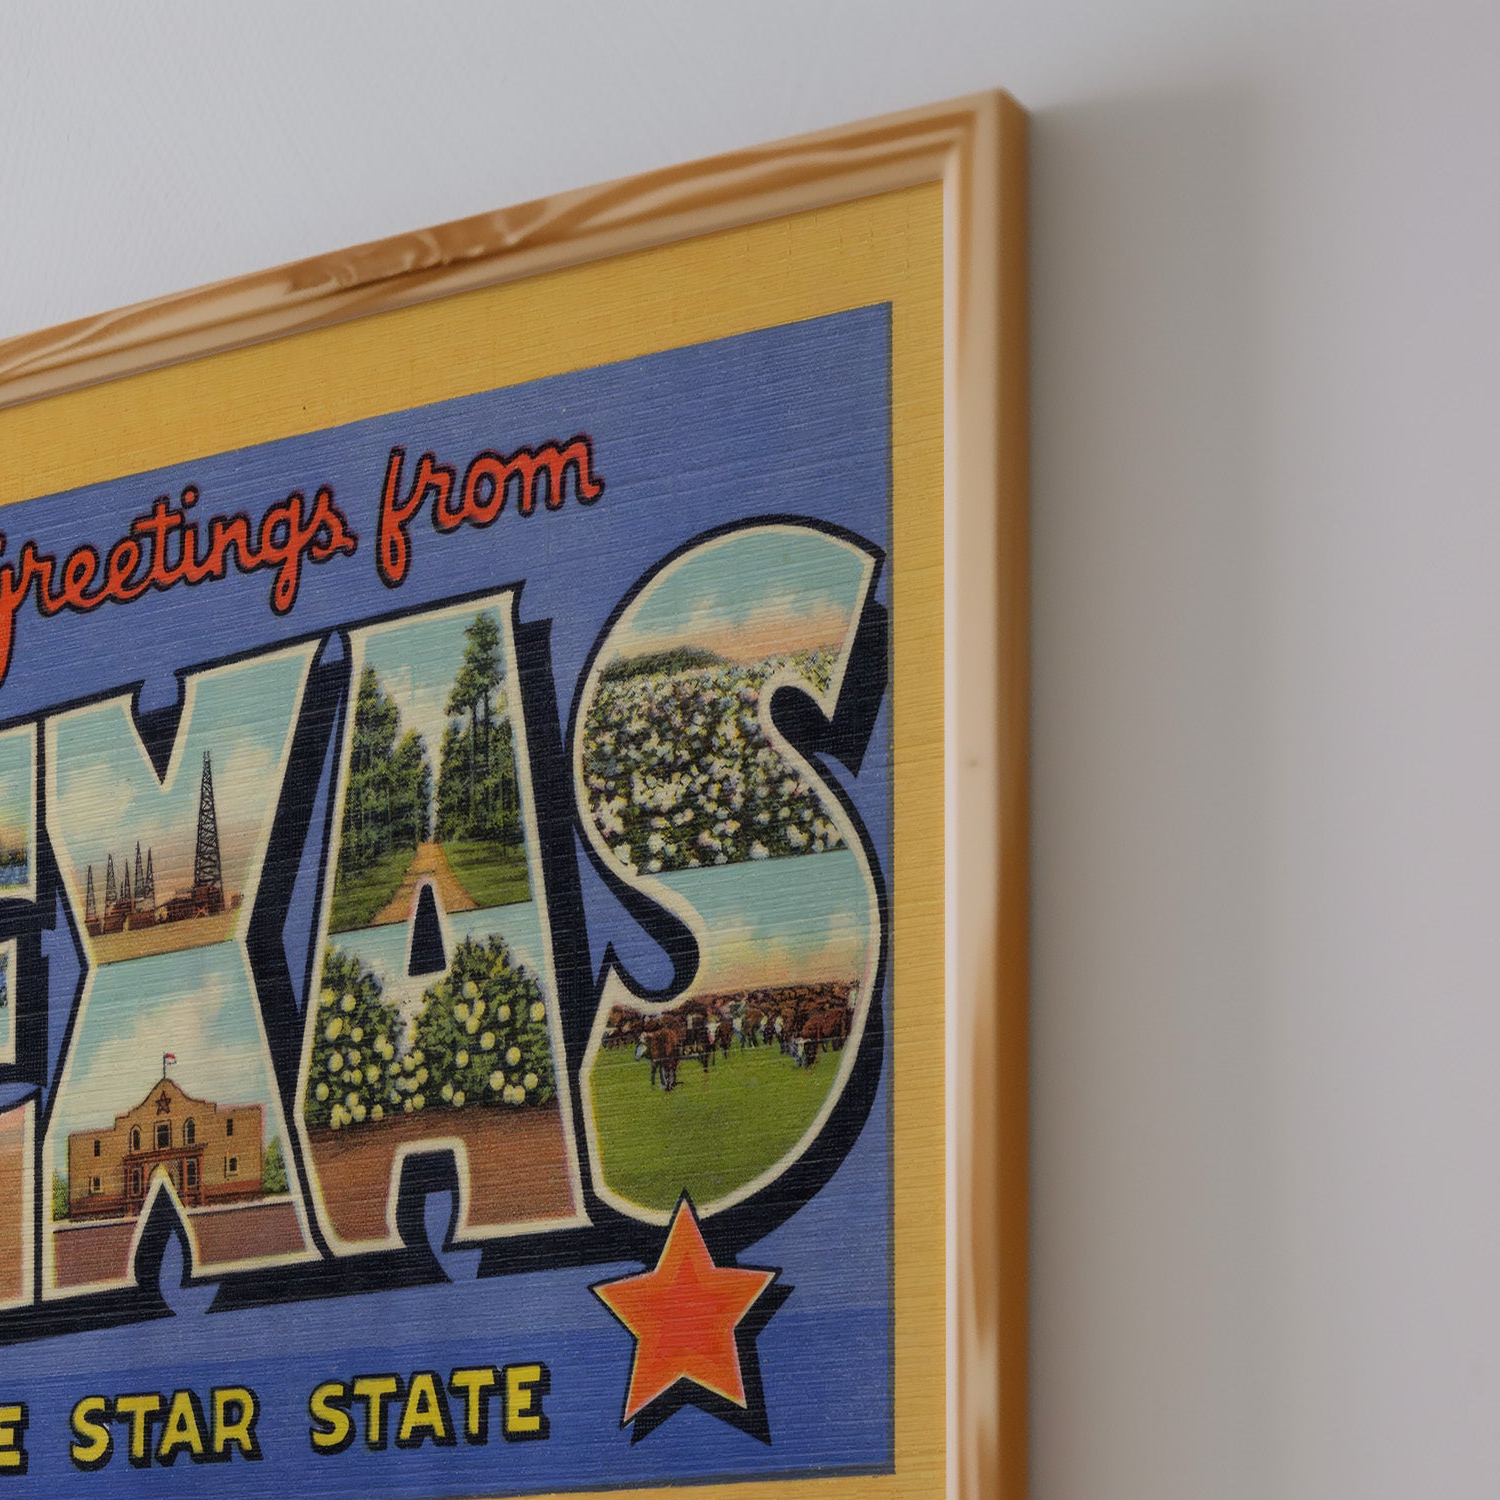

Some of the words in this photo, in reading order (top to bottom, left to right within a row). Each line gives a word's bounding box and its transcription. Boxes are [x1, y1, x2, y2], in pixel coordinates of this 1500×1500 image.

[375, 433, 604, 588] from
[69, 1384, 264, 1472] STAR
[308, 1361, 551, 1455] STATE
